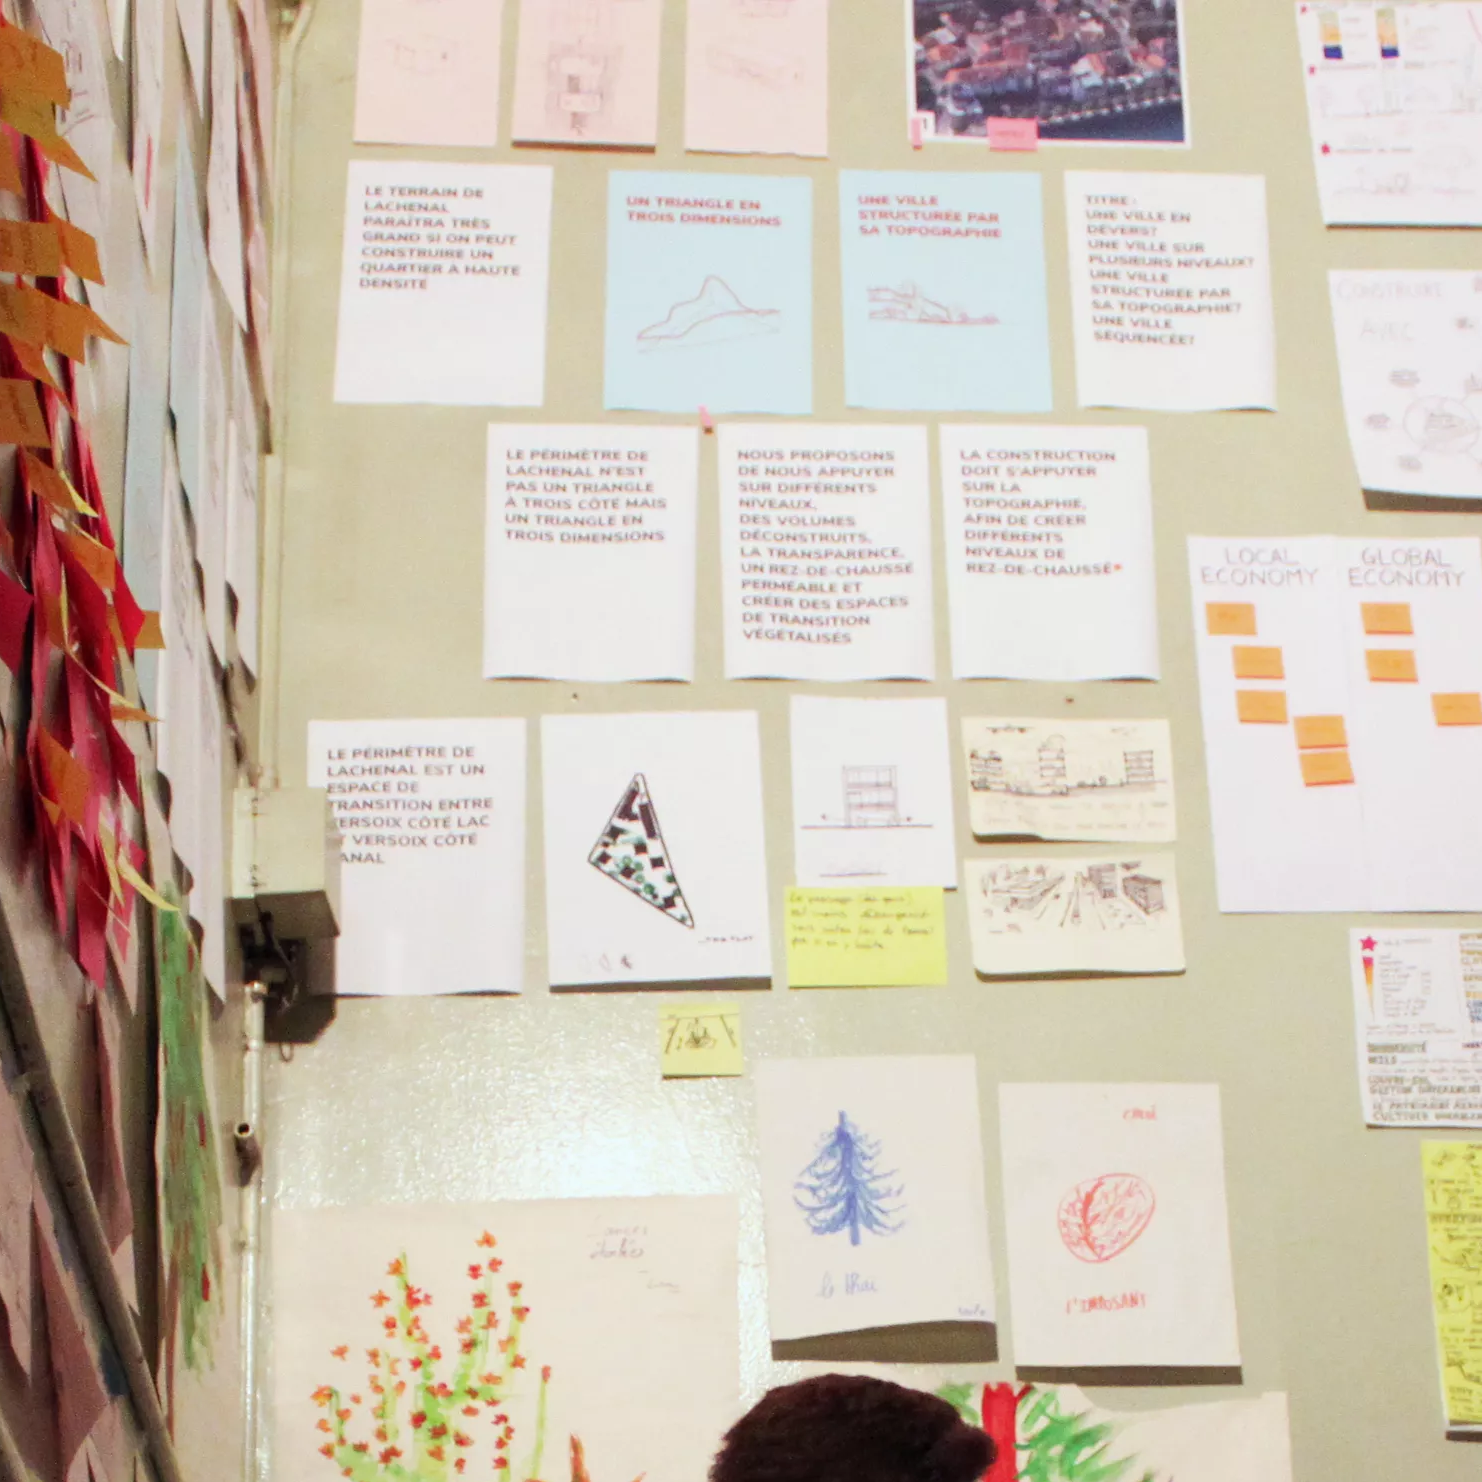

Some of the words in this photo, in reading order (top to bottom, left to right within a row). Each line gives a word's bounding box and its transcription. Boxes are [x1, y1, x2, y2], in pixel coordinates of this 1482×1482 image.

[365, 185, 383, 196] LE
[389, 186, 458, 197] TERRAIN
[463, 188, 484, 198] DE
[364, 201, 449, 213] LACHENAL
[627, 195, 649, 206] UN
[656, 196, 734, 210] TRIANGLE
[740, 200, 761, 210] EN
[859, 195, 890, 205] UNE
[896, 195, 938, 206] VILLE
[627, 211, 675, 223] TROIS
[680, 212, 781, 226] DIMENSIONS
[967, 211, 999, 223] PAR
[860, 225, 879, 236] SA
[887, 225, 1002, 238] TOPOGRAPHIE
[362, 231, 420, 243] GRAND
[427, 233, 441, 243] SI
[446, 234, 470, 244] ON
[475, 235, 517, 246] PEUT
[361, 247, 464, 259] CONSTRUIRE
[470, 249, 494, 260] UN
[360, 262, 443, 275] QUARTIER
[465, 264, 521, 276] HAUTE
[506, 449, 525, 460] LE
[627, 450, 649, 461] DE
[738, 449, 784, 460] NOUS
[790, 449, 895, 461] PROPOSONS
[960, 449, 981, 460] LA
[987, 449, 1116, 462] CONSTRUCTION
[506, 465, 593, 477] LACHENAL
[738, 465, 759, 476] DE
[765, 465, 811, 476] NOUS
[818, 466, 895, 477] APPUYER
[961, 465, 999, 476] DOIT
[506, 481, 537, 492] PAS
[543, 482, 567, 493] UN
[573, 482, 654, 493] TRIANGLE
[739, 482, 771, 492] SUR
[962, 481, 994, 492] SUR
[1000, 482, 1021, 492] LA
[523, 497, 572, 509] TROIS
[625, 497, 667, 509] MAIS
[506, 513, 529, 524] UN
[535, 513, 616, 526] TRIANGLE
[623, 513, 643, 525] EN
[740, 514, 771, 525] DES
[777, 515, 856, 526] VOLUMES
[964, 514, 1002, 524] AFIN
[1007, 515, 1028, 526] DE
[505, 529, 554, 541] TROIS
[560, 530, 665, 543] DIMENSIONS
[741, 546, 761, 557] LA
[966, 546, 1038, 559] NIVEAUX
[1044, 548, 1065, 559] DE
[1224, 547, 1299, 566] LOCAL
[1361, 547, 1451, 567] GLOBAL
[741, 563, 764, 574] UN
[1200, 567, 1319, 586] ECONOMY
[1348, 567, 1466, 587] ECONOMY
[843, 581, 862, 593] ET
[799, 597, 830, 609] DES
[837, 595, 909, 609] ESPACES
[742, 612, 763, 623] DE
[770, 612, 870, 627] TRANSITION
[327, 749, 346, 760] LE
[452, 746, 475, 758] DE
[327, 765, 418, 777] LACHENAL
[425, 764, 454, 775] EST
[461, 764, 485, 775] UN
[327, 781, 392, 793] ESPACE
[397, 781, 419, 793] DE
[438, 797, 493, 810] ENTRE
[334, 816, 402, 829] ERSOIX
[457, 815, 490, 828] LAC
[352, 835, 427, 846] VERSOIX
[340, 852, 385, 863] ANAL
